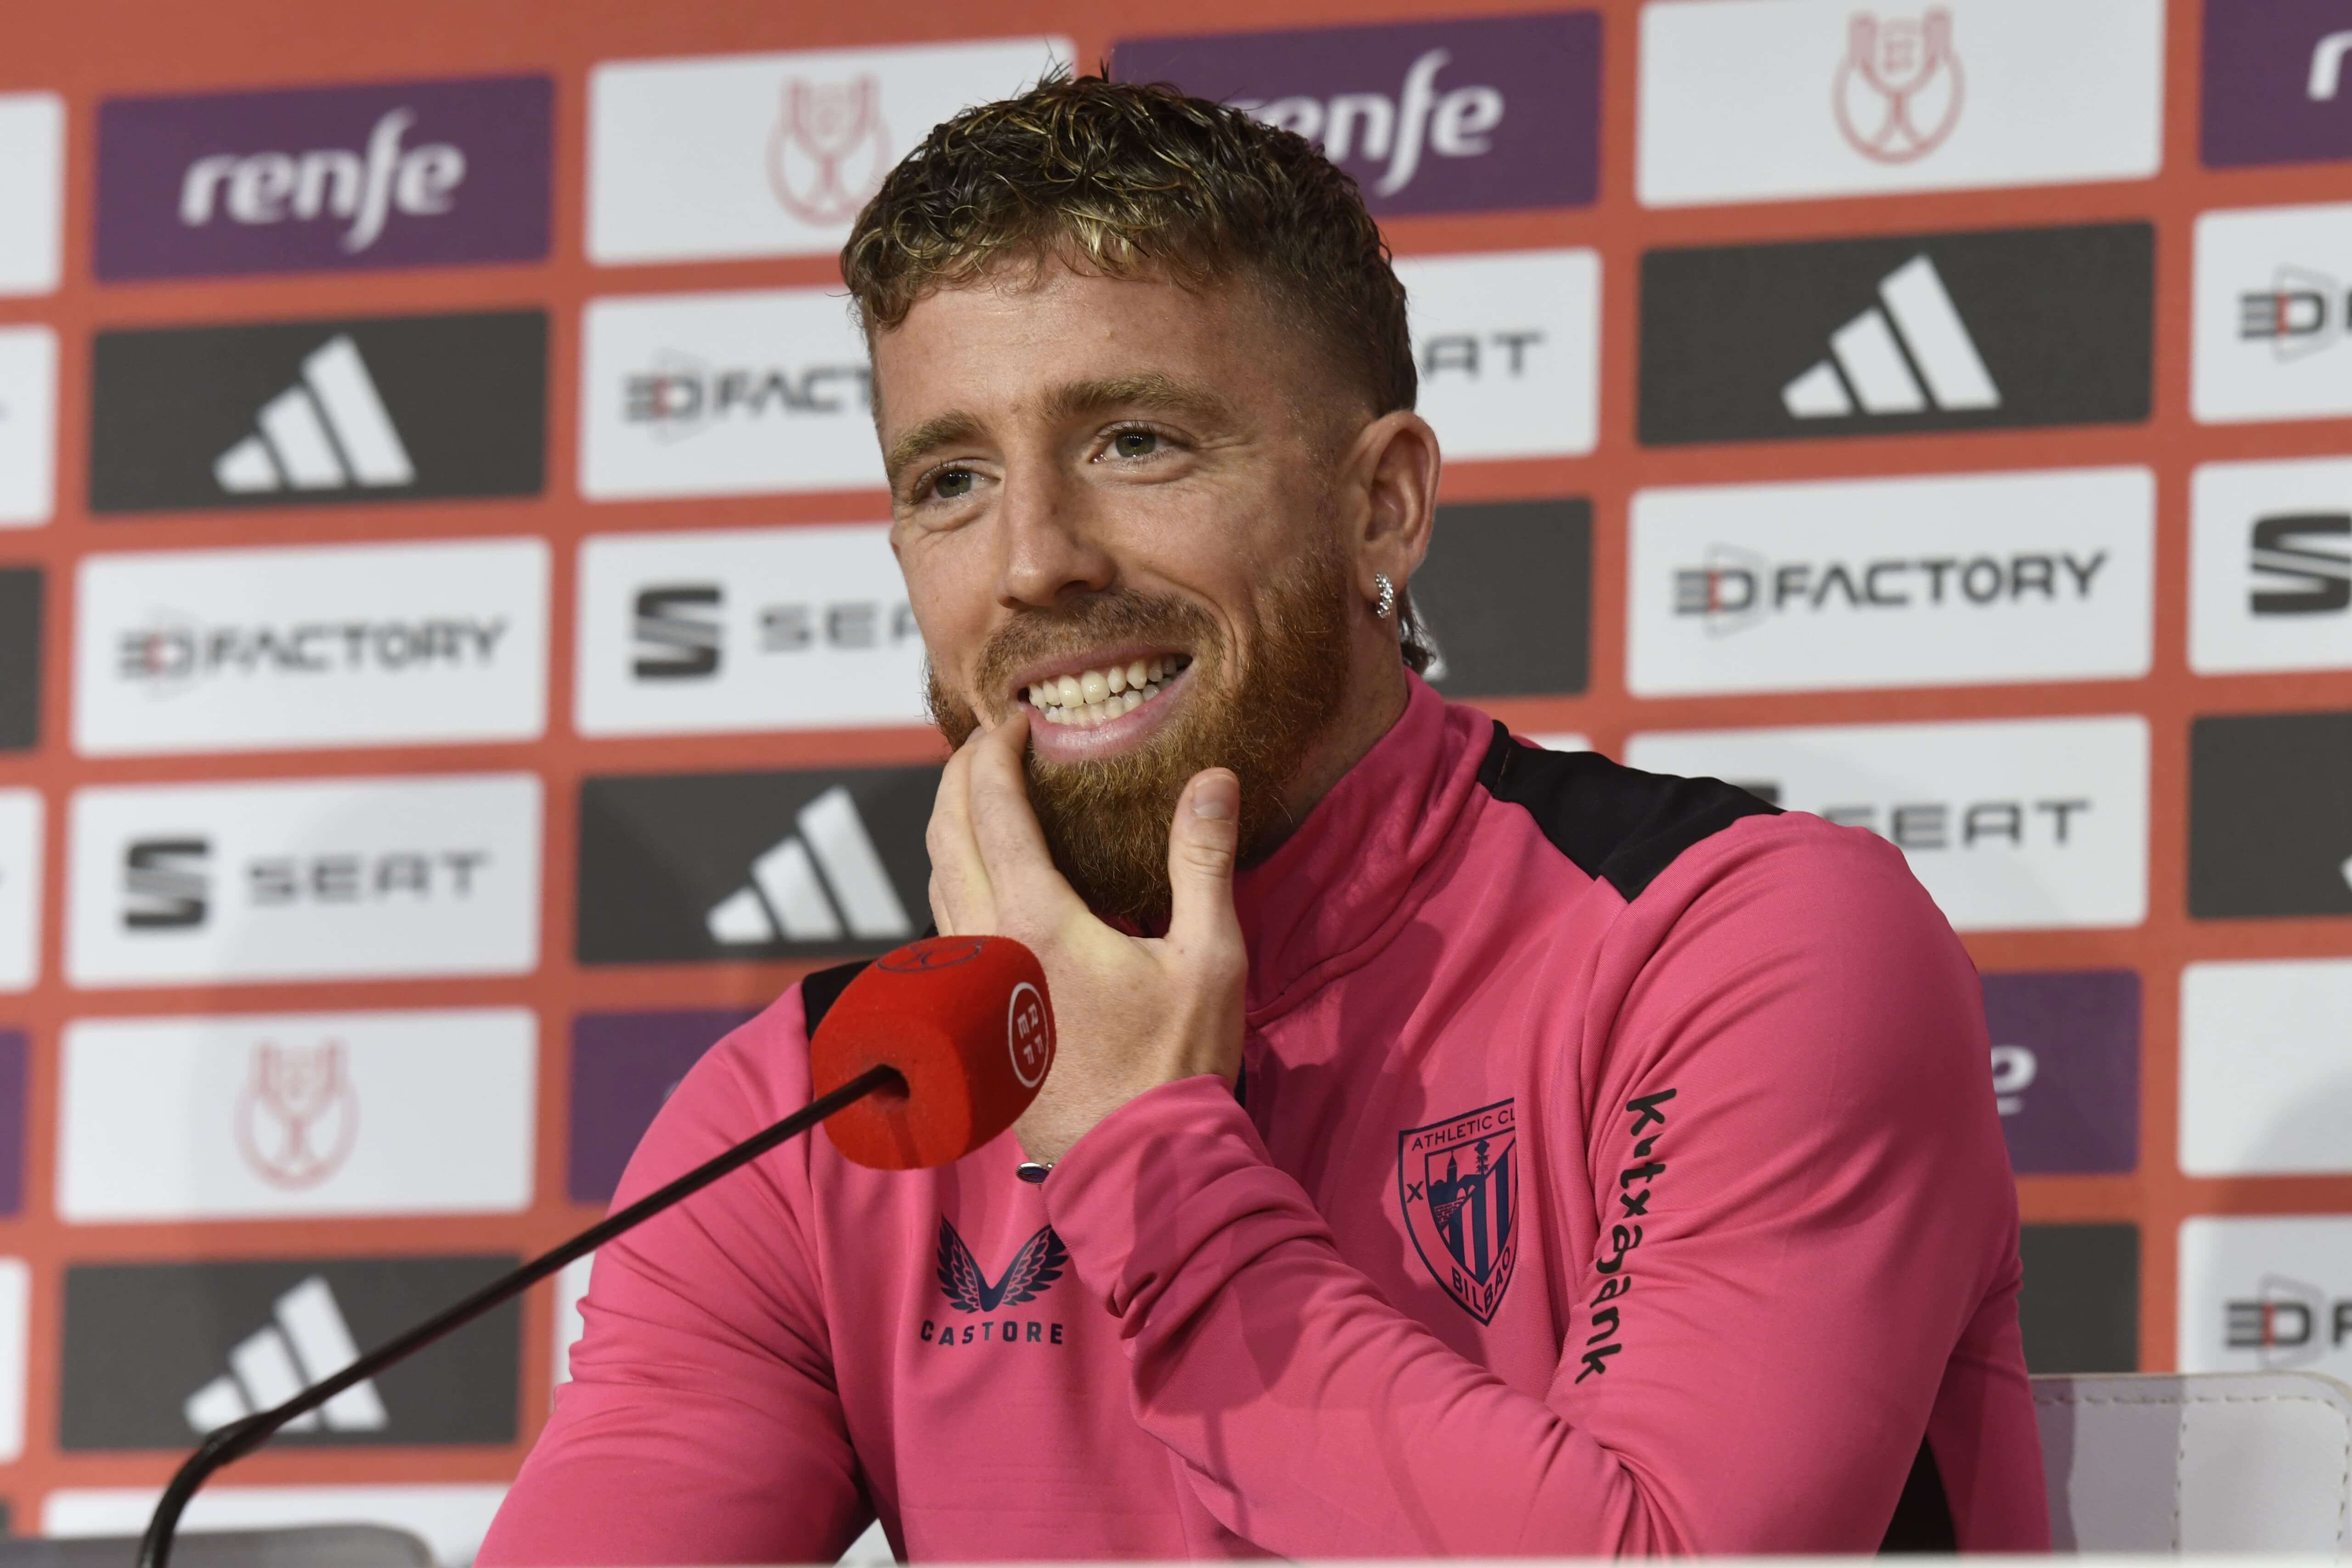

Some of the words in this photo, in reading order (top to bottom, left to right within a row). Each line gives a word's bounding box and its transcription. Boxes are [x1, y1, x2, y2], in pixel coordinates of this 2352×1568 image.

[1226, 47, 1505, 198] enfe
[180, 106, 466, 254] renfe
[1424, 331, 1545, 379] AT
[1773, 551, 2107, 611] FACTORY
[205, 615, 508, 675] FACTORY
[757, 602, 923, 655] SEA
[247, 850, 490, 906] SEAT
[1411, 1115, 1493, 1152] ATHLETIC
[1498, 1108, 1515, 1125] CL
[1452, 1246, 1510, 1314] BILBAO
[920, 1319, 1063, 1346] CASTORE
